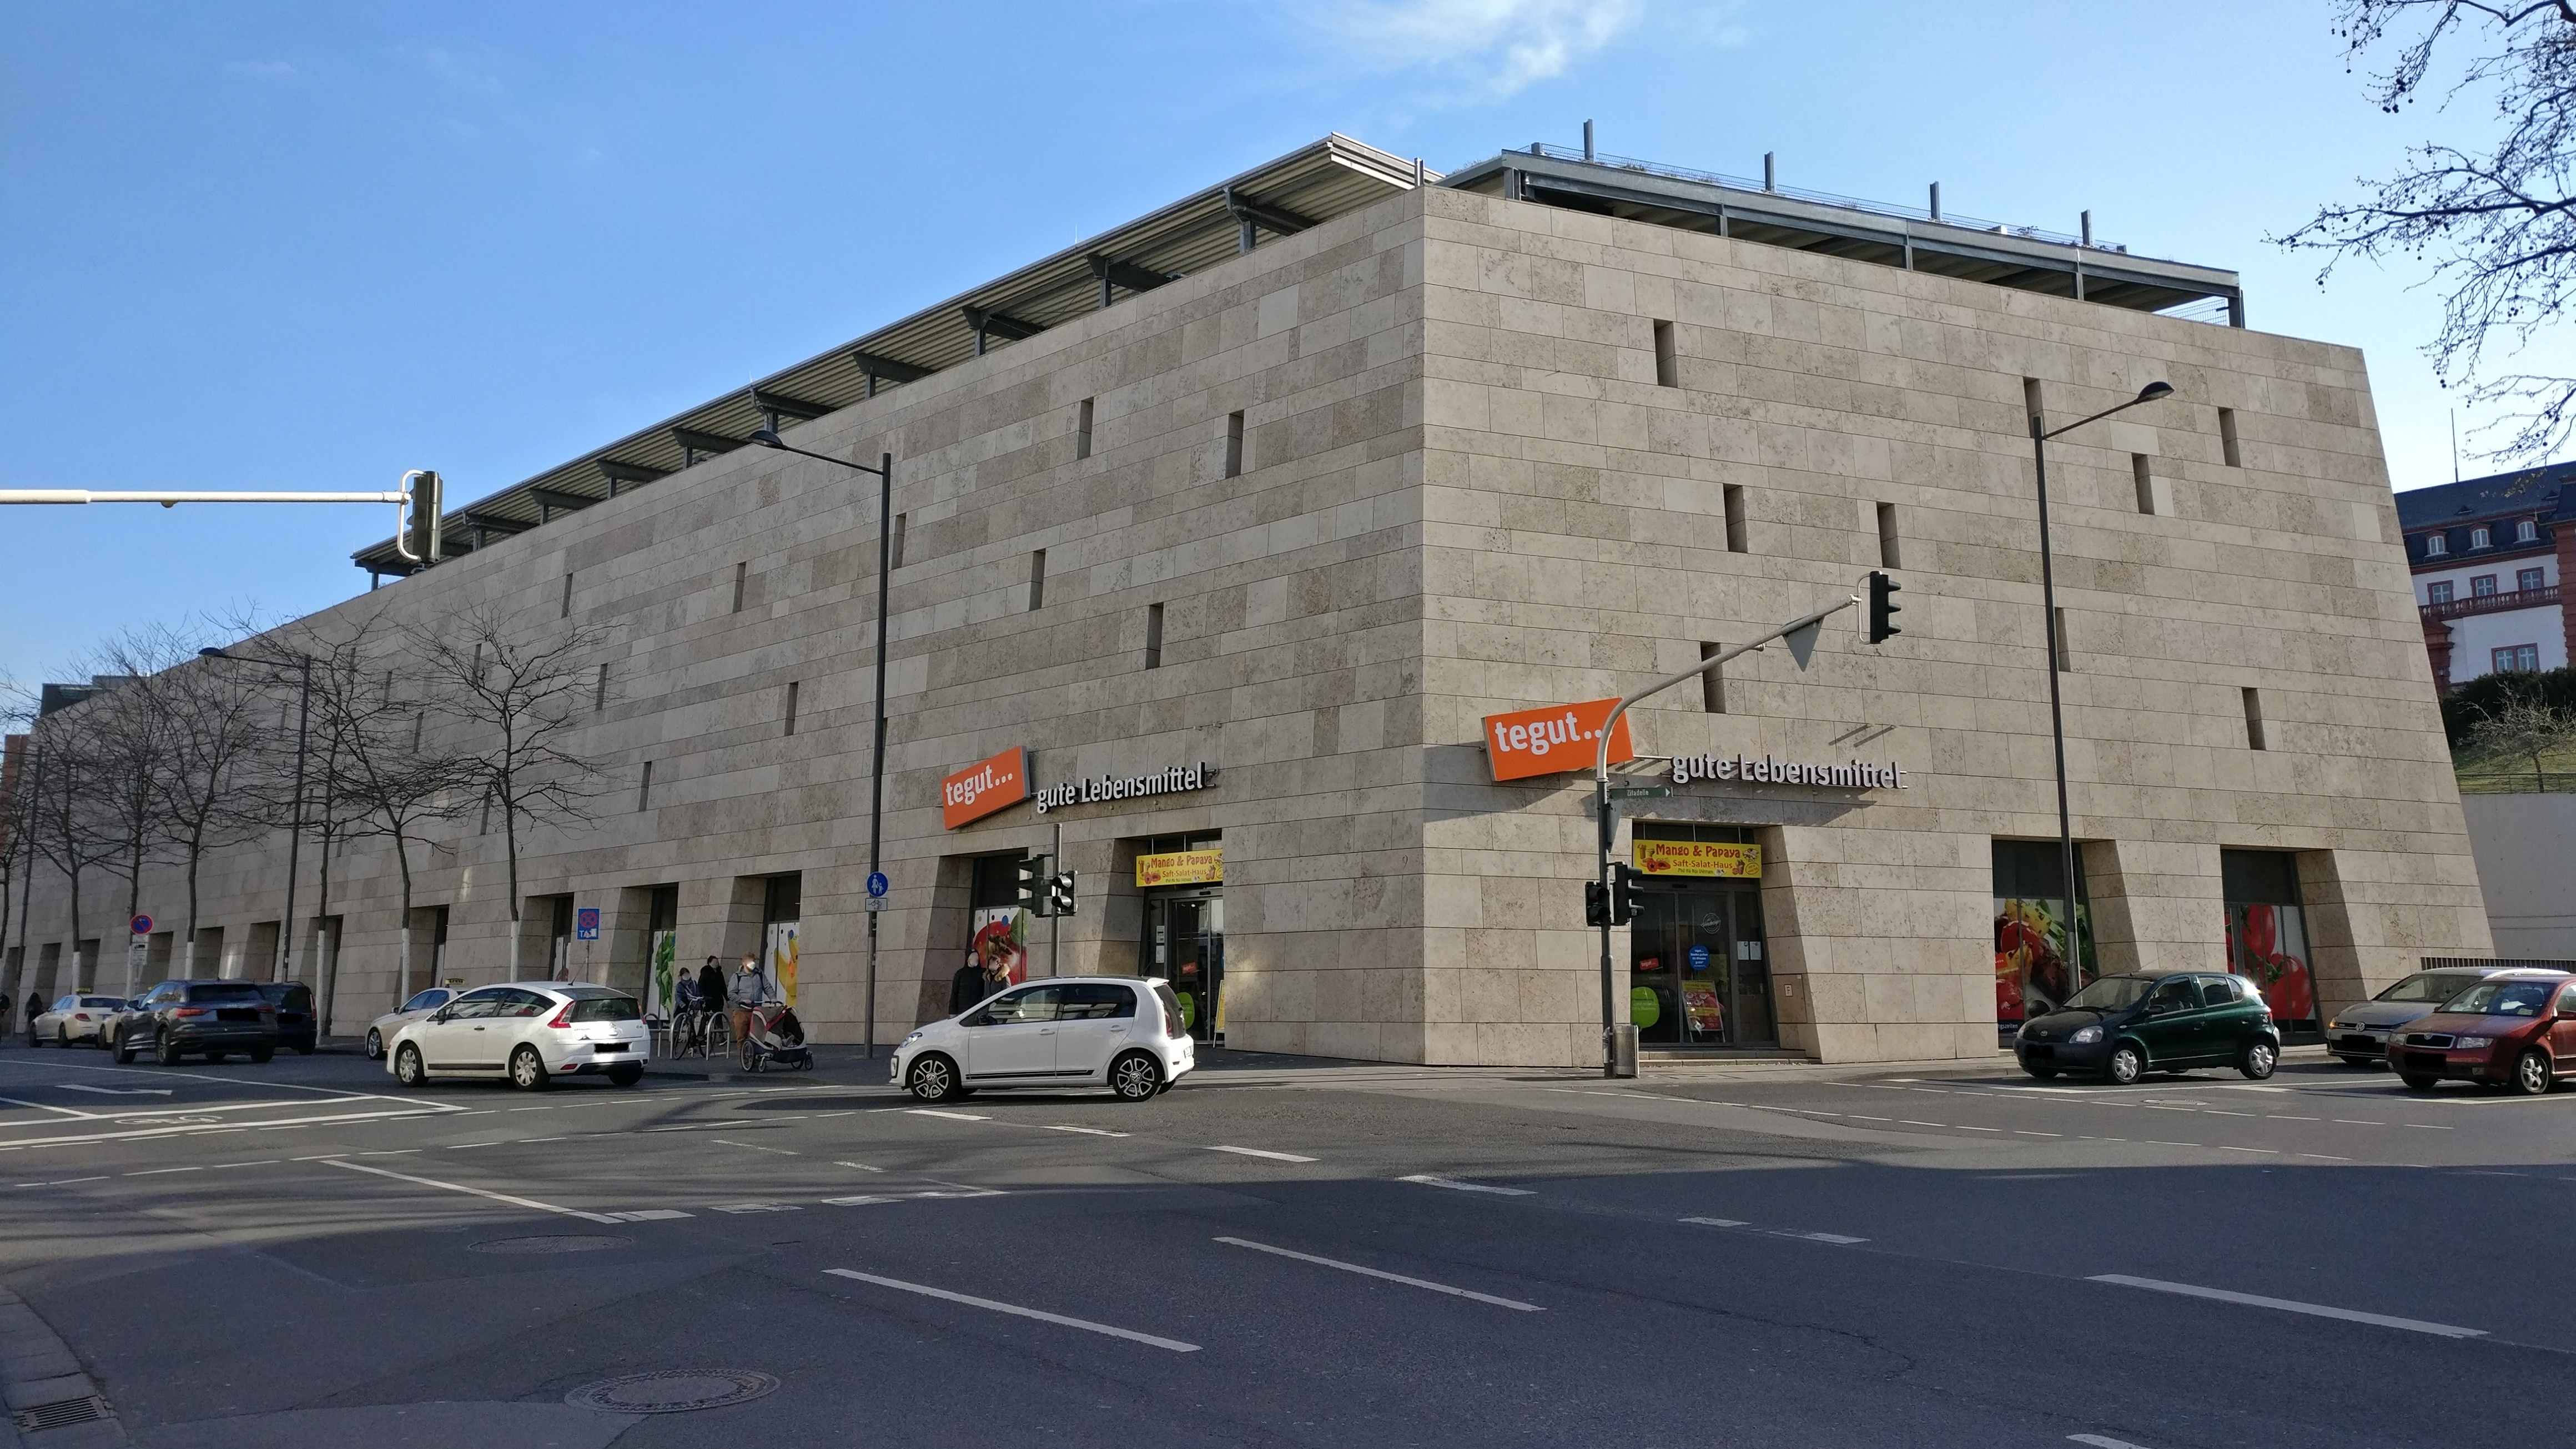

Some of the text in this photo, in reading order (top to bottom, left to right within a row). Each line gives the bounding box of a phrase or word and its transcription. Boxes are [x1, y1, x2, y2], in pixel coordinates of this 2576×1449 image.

[1495, 711, 1613, 756] tegut..
[1672, 753, 1903, 789] gute Lebensmittel
[945, 764, 1013, 806] tegut...
[1037, 761, 1204, 814] gute Lebensmittel
[1151, 855, 1212, 868] Mango & Papaya
[1656, 843, 1740, 858] Mango & Papaya
[1162, 869, 1207, 878] Saft-Salat-Haus
[1673, 859, 1733, 869] Saft-Salat-Haus
